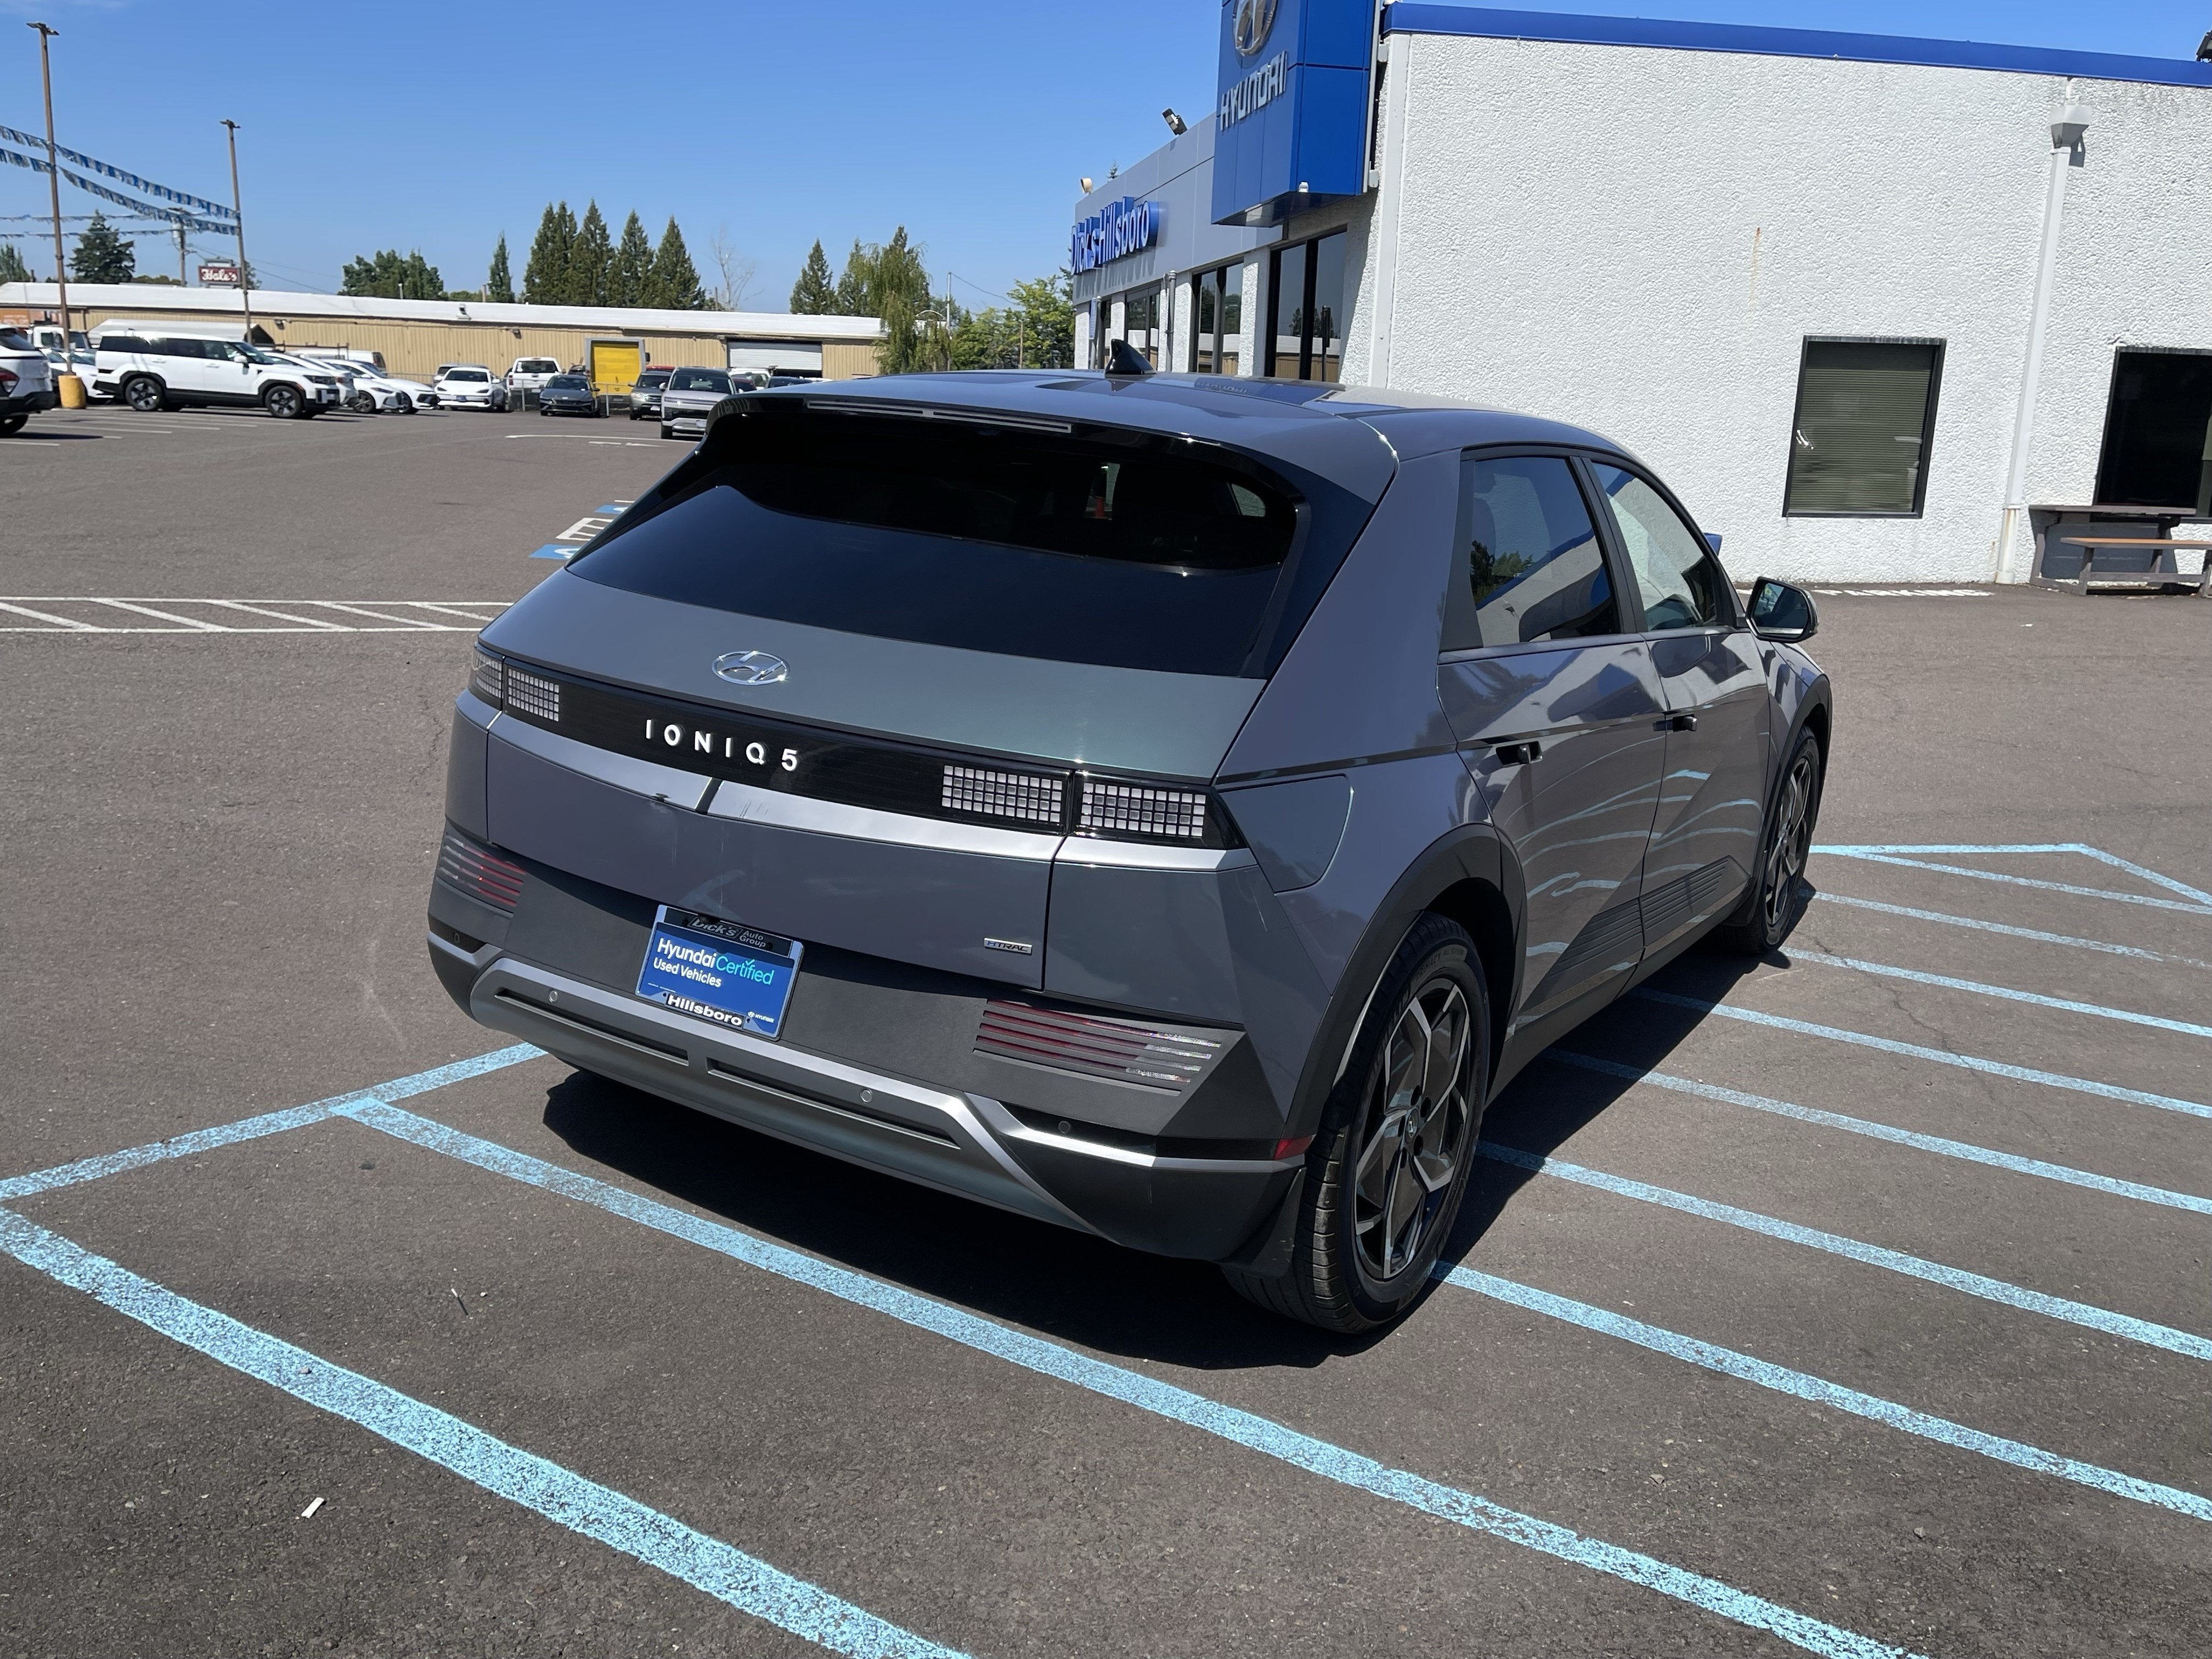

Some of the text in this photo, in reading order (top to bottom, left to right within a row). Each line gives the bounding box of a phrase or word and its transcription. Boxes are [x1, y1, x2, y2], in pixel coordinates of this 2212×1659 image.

[1220, 50, 1288, 131] HYUNDAI
[1071, 197, 1152, 275] Dick's Hillsboro
[646, 719, 798, 771] IONIQ 5
[692, 919, 764, 941] Dick's Auto
[739, 935, 766, 948] Group
[988, 940, 1028, 952] HTRAC
[653, 957, 722, 988] Used Vehicles
[668, 994, 742, 1026] Hillsboro
